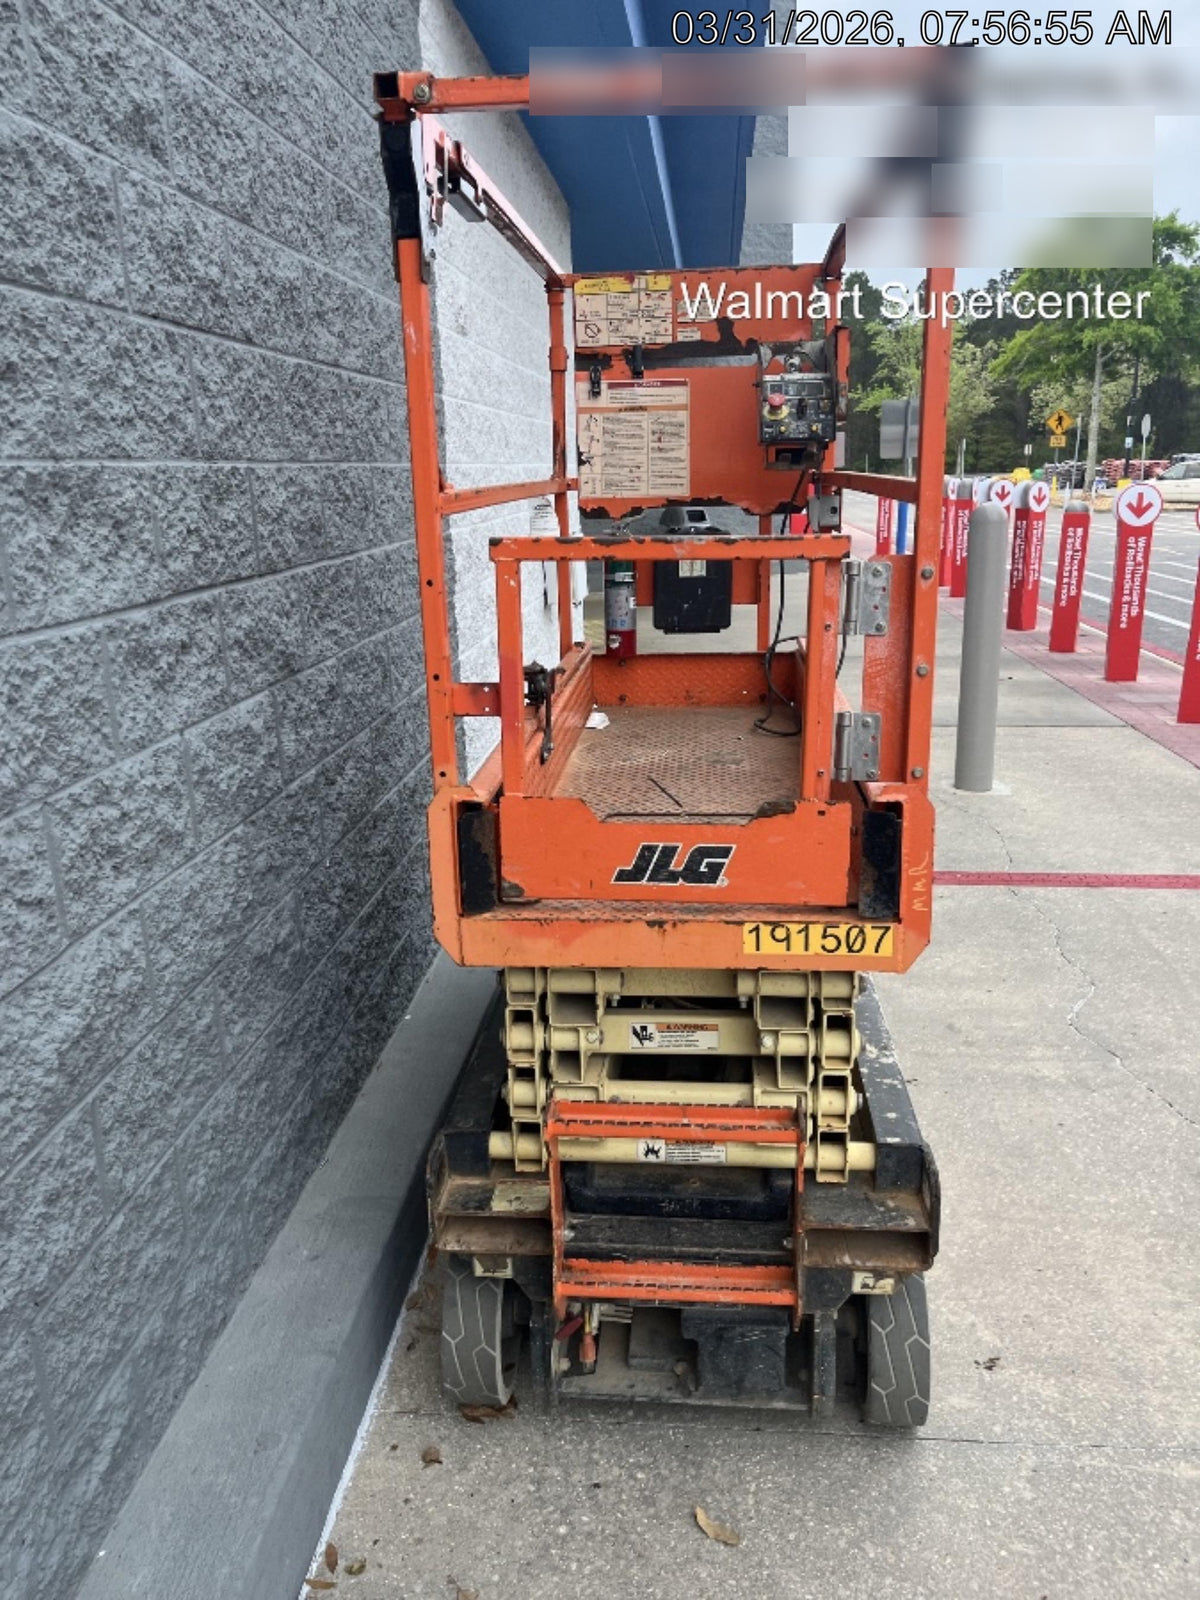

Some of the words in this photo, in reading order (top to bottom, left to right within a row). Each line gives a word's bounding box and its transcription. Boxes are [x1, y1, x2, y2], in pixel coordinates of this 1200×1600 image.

[1127, 536, 1136, 547] of
[1129, 564, 1145, 617] Thousands
[1119, 604, 1129, 629] more
[609, 842, 736, 887] JLG
[748, 923, 892, 954] 191507
